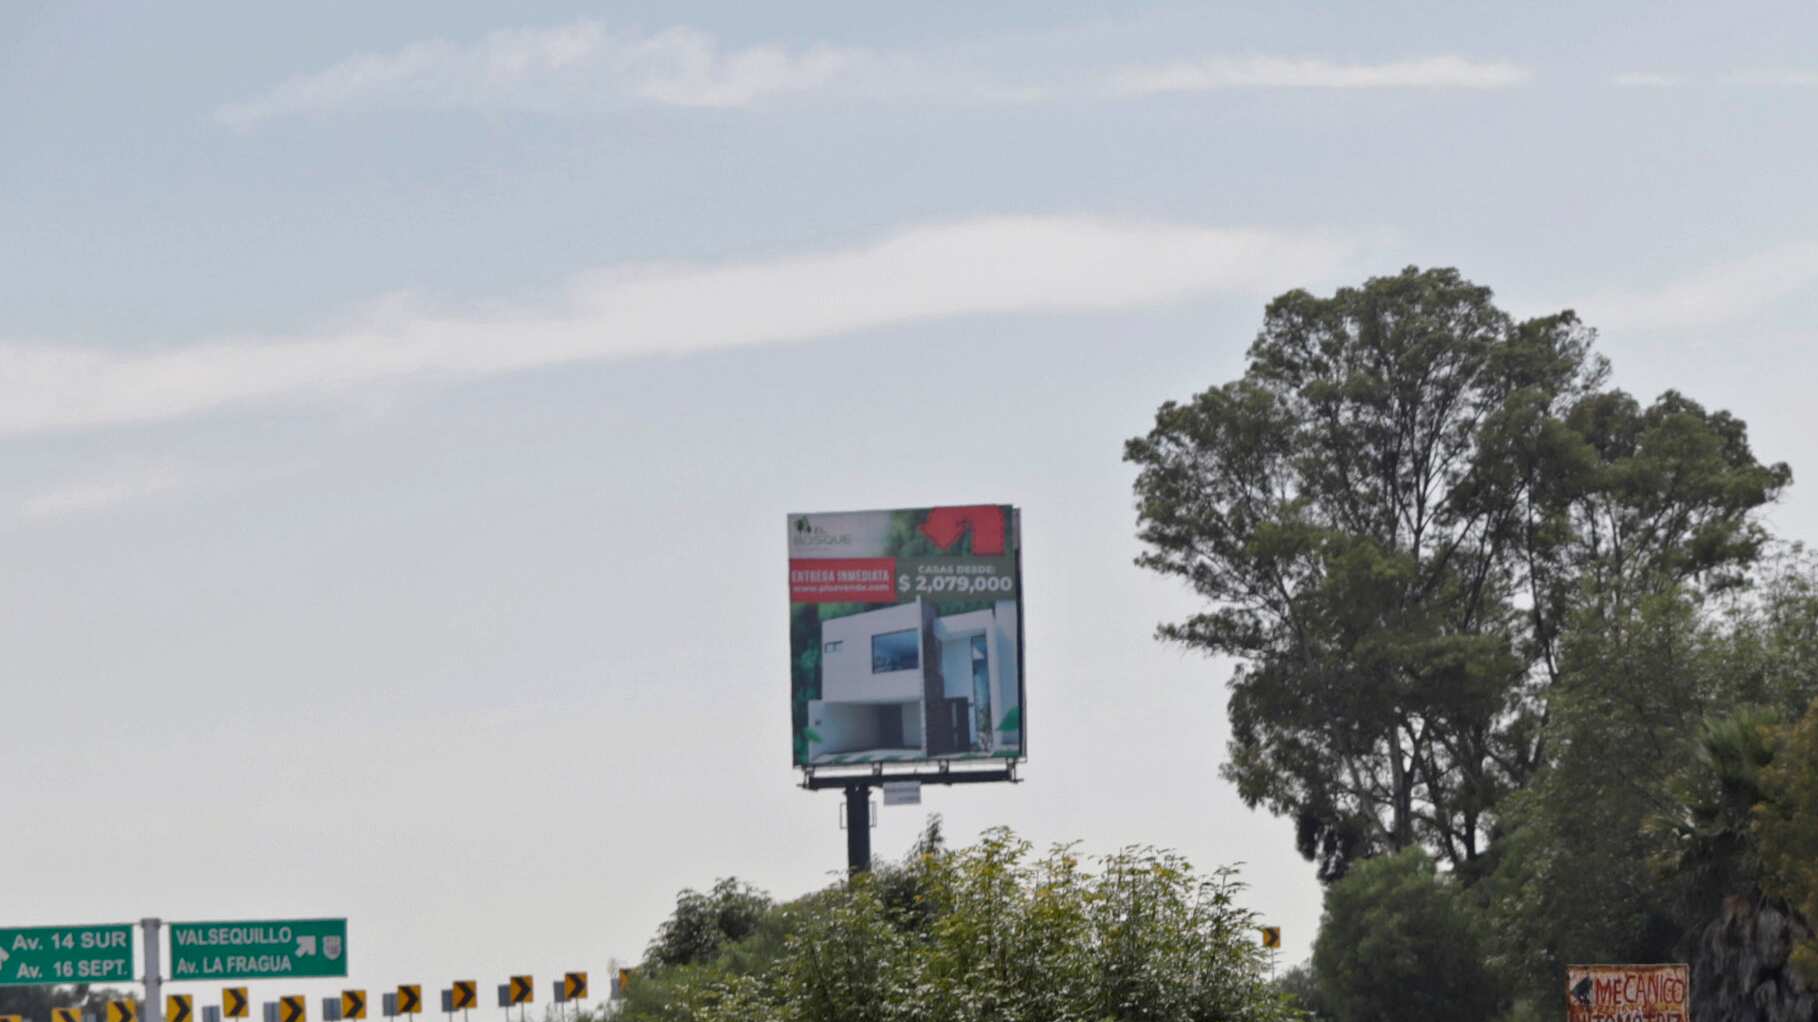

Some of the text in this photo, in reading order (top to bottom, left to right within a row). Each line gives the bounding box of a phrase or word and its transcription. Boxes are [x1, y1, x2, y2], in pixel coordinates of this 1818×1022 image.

[791, 569, 889, 583] ENTREGA INMEDIATA
[918, 565, 954, 574] CASAS
[898, 574, 1013, 594] $ 2,079,000
[12, 931, 128, 950] Av. 14 SUR
[175, 926, 293, 945] VALSEQUILLO
[16, 959, 128, 979] Av. 16 SEPT.
[176, 955, 292, 974] Av. LA FRAGUA
[1594, 973, 1686, 1005] MECANICO
